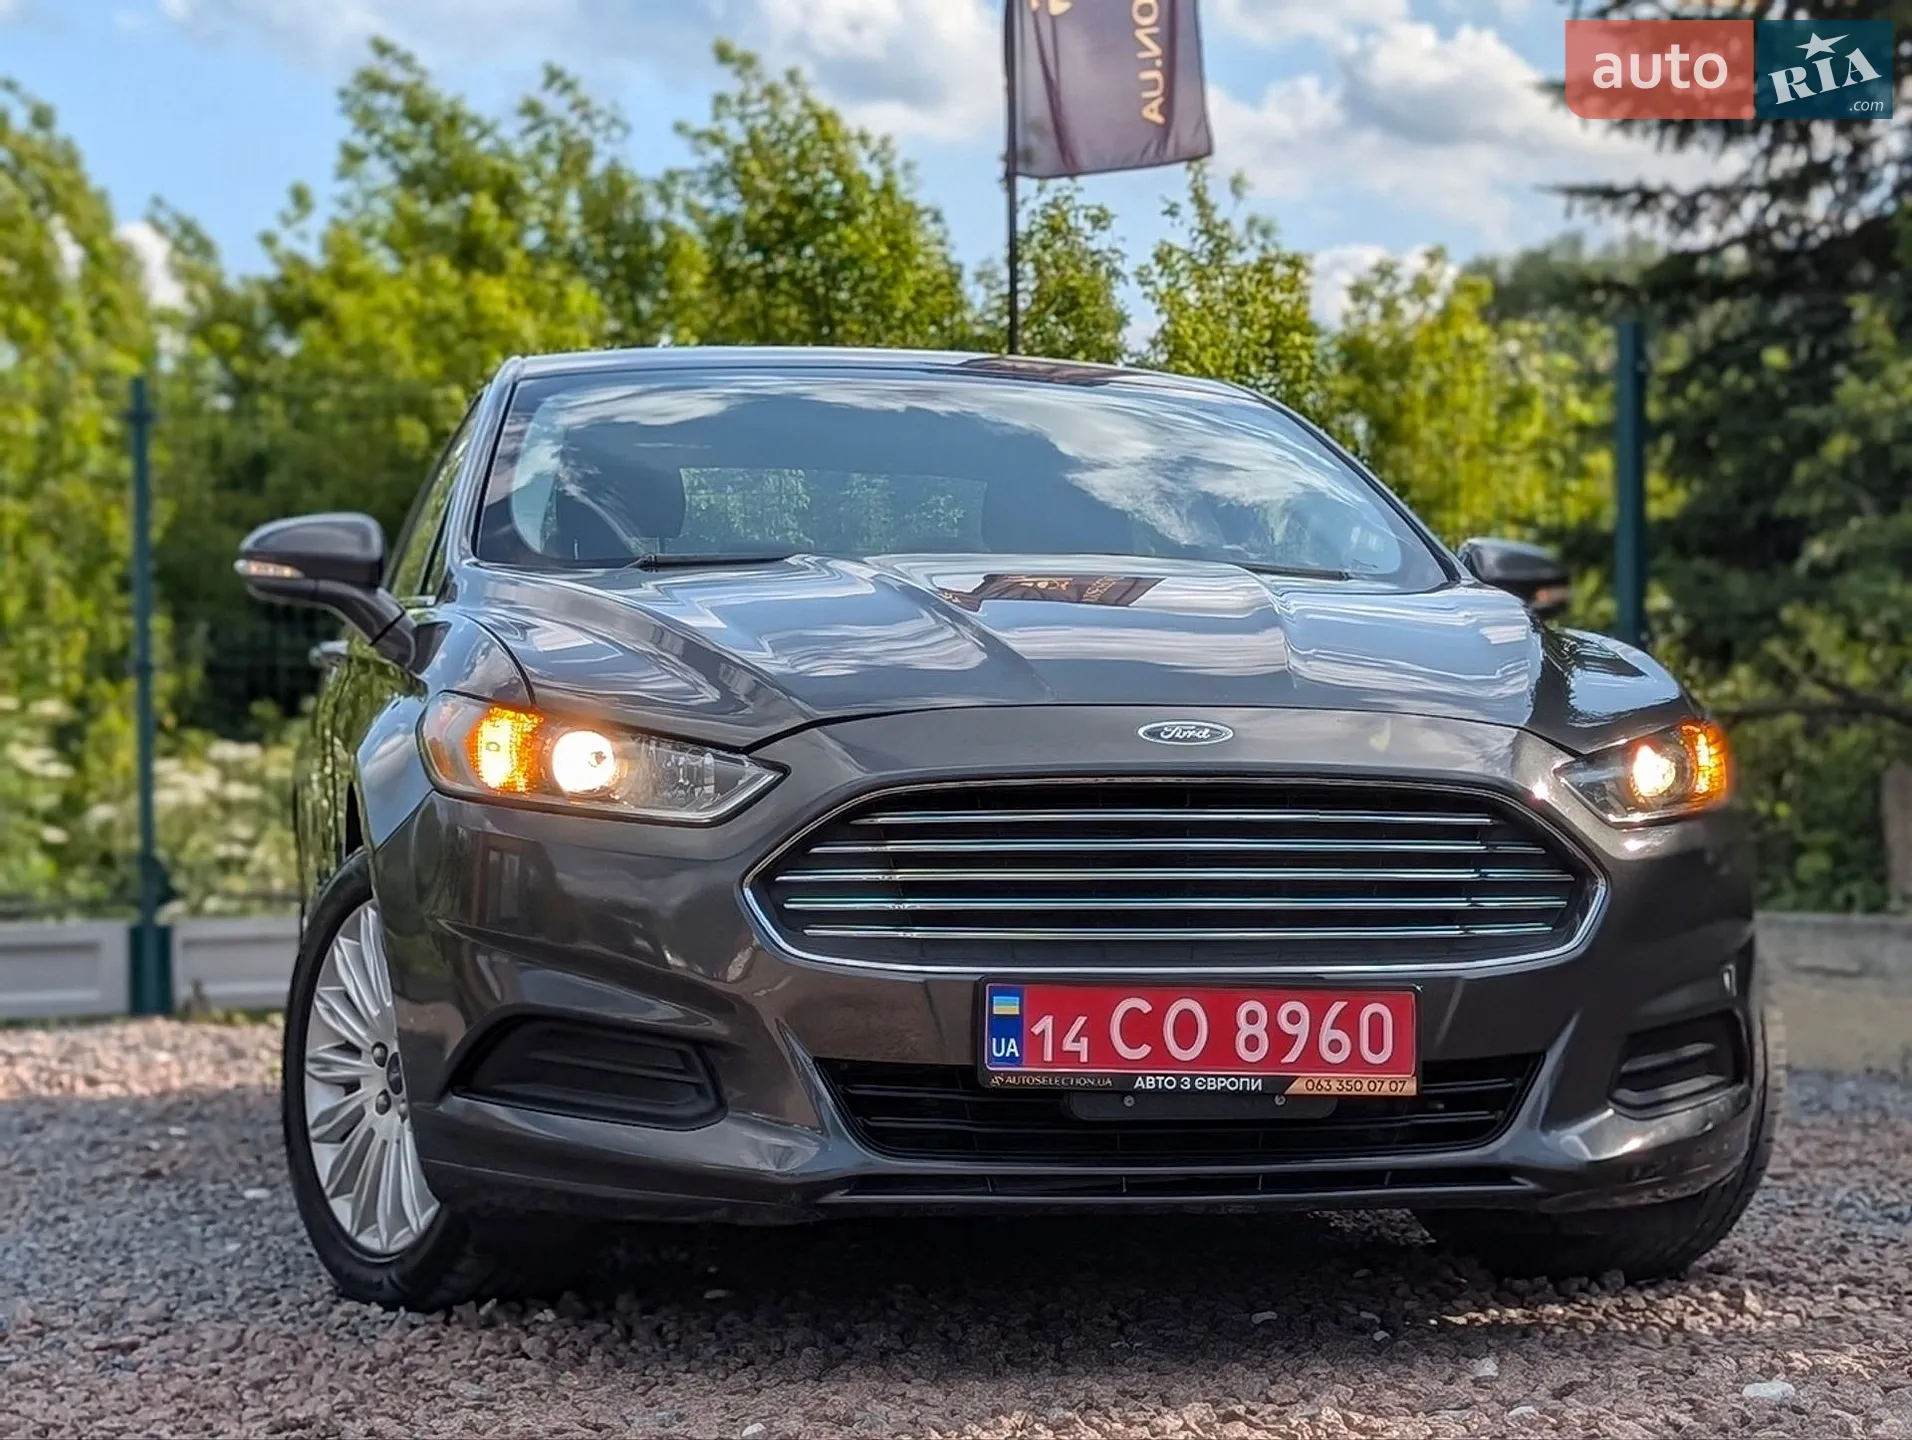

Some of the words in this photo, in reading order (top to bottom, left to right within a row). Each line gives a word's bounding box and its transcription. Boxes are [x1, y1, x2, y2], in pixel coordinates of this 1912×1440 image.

[1160, 725, 1211, 739] Ford
[1030, 1014, 1089, 1064] 14
[1109, 996, 1210, 1062] CO
[1234, 999, 1395, 1065] 8960
[992, 1037, 1020, 1058] UA
[1133, 1076, 1177, 1090] АВТО
[1194, 1077, 1263, 1092] ЄВРОПИ
[1305, 1079, 1333, 1092] 063
[1336, 1079, 1364, 1092] 350
[1367, 1080, 1385, 1093] 07
[1388, 1080, 1407, 1093] 07
